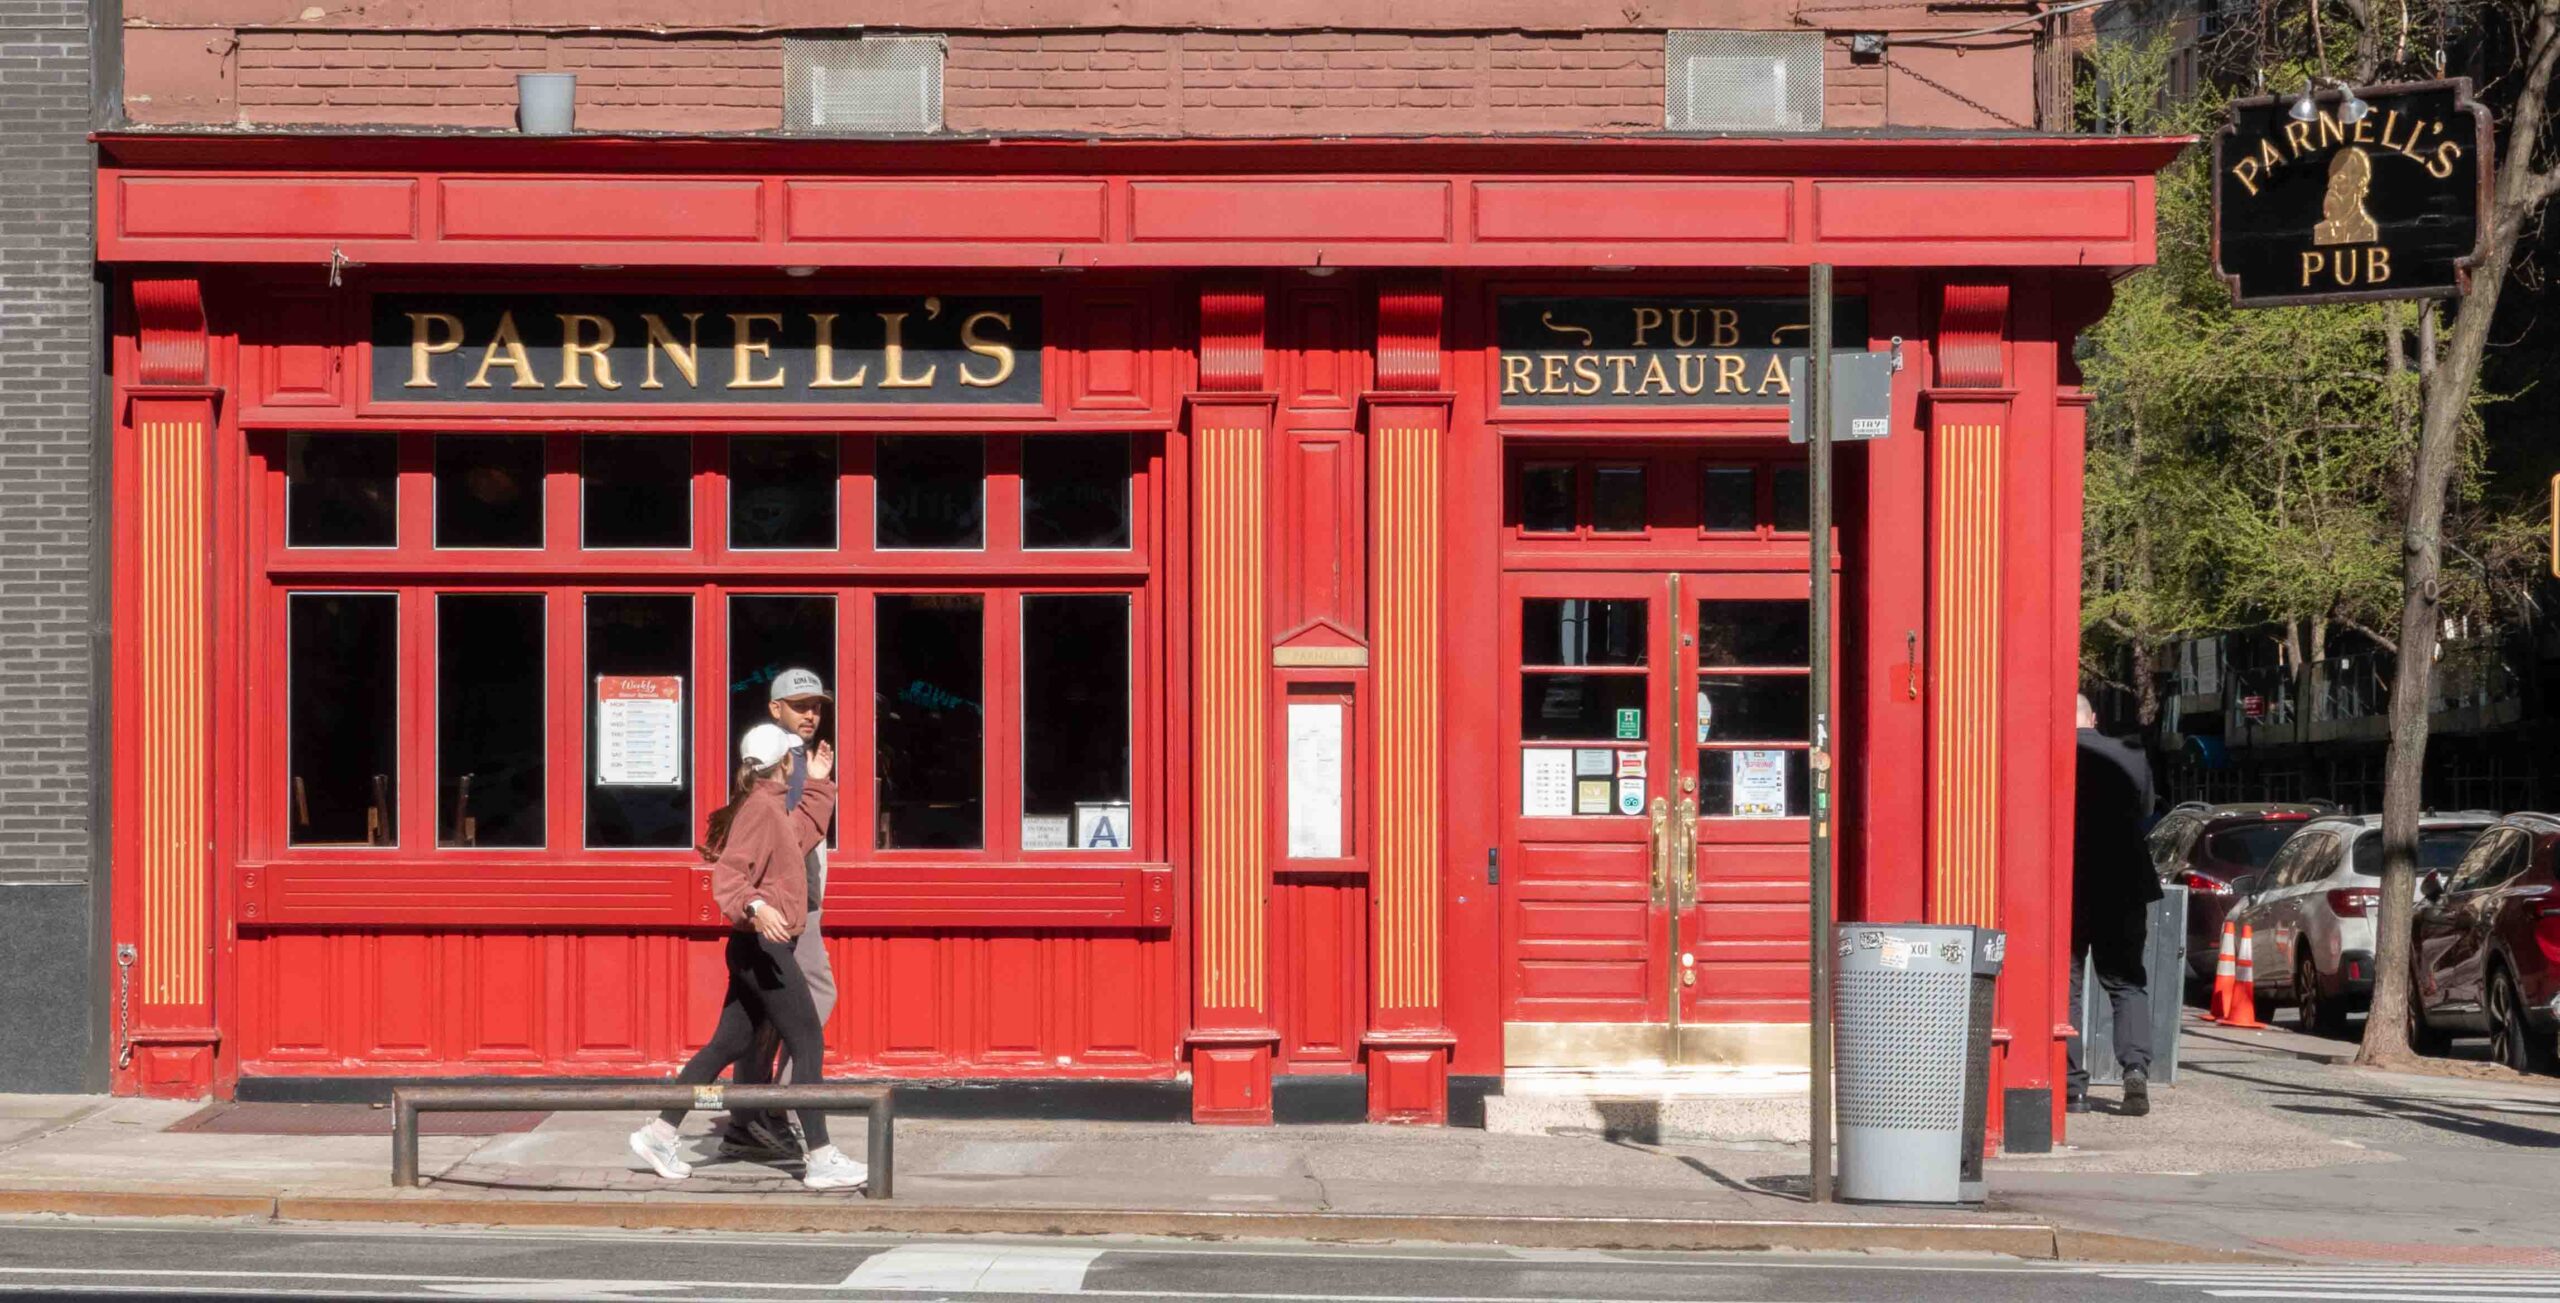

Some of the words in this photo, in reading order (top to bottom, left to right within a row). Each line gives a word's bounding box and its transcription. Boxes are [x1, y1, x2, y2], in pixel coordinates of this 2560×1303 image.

[2232, 106, 2462, 196] PARNELL'S
[2302, 248, 2391, 287] PUB
[403, 298, 1015, 389] PARNELL'S
[1632, 308, 1740, 347] PUB
[1502, 354, 1791, 396] RESTAURA
[621, 680, 656, 693] Weekly
[1088, 815, 1119, 848] A
